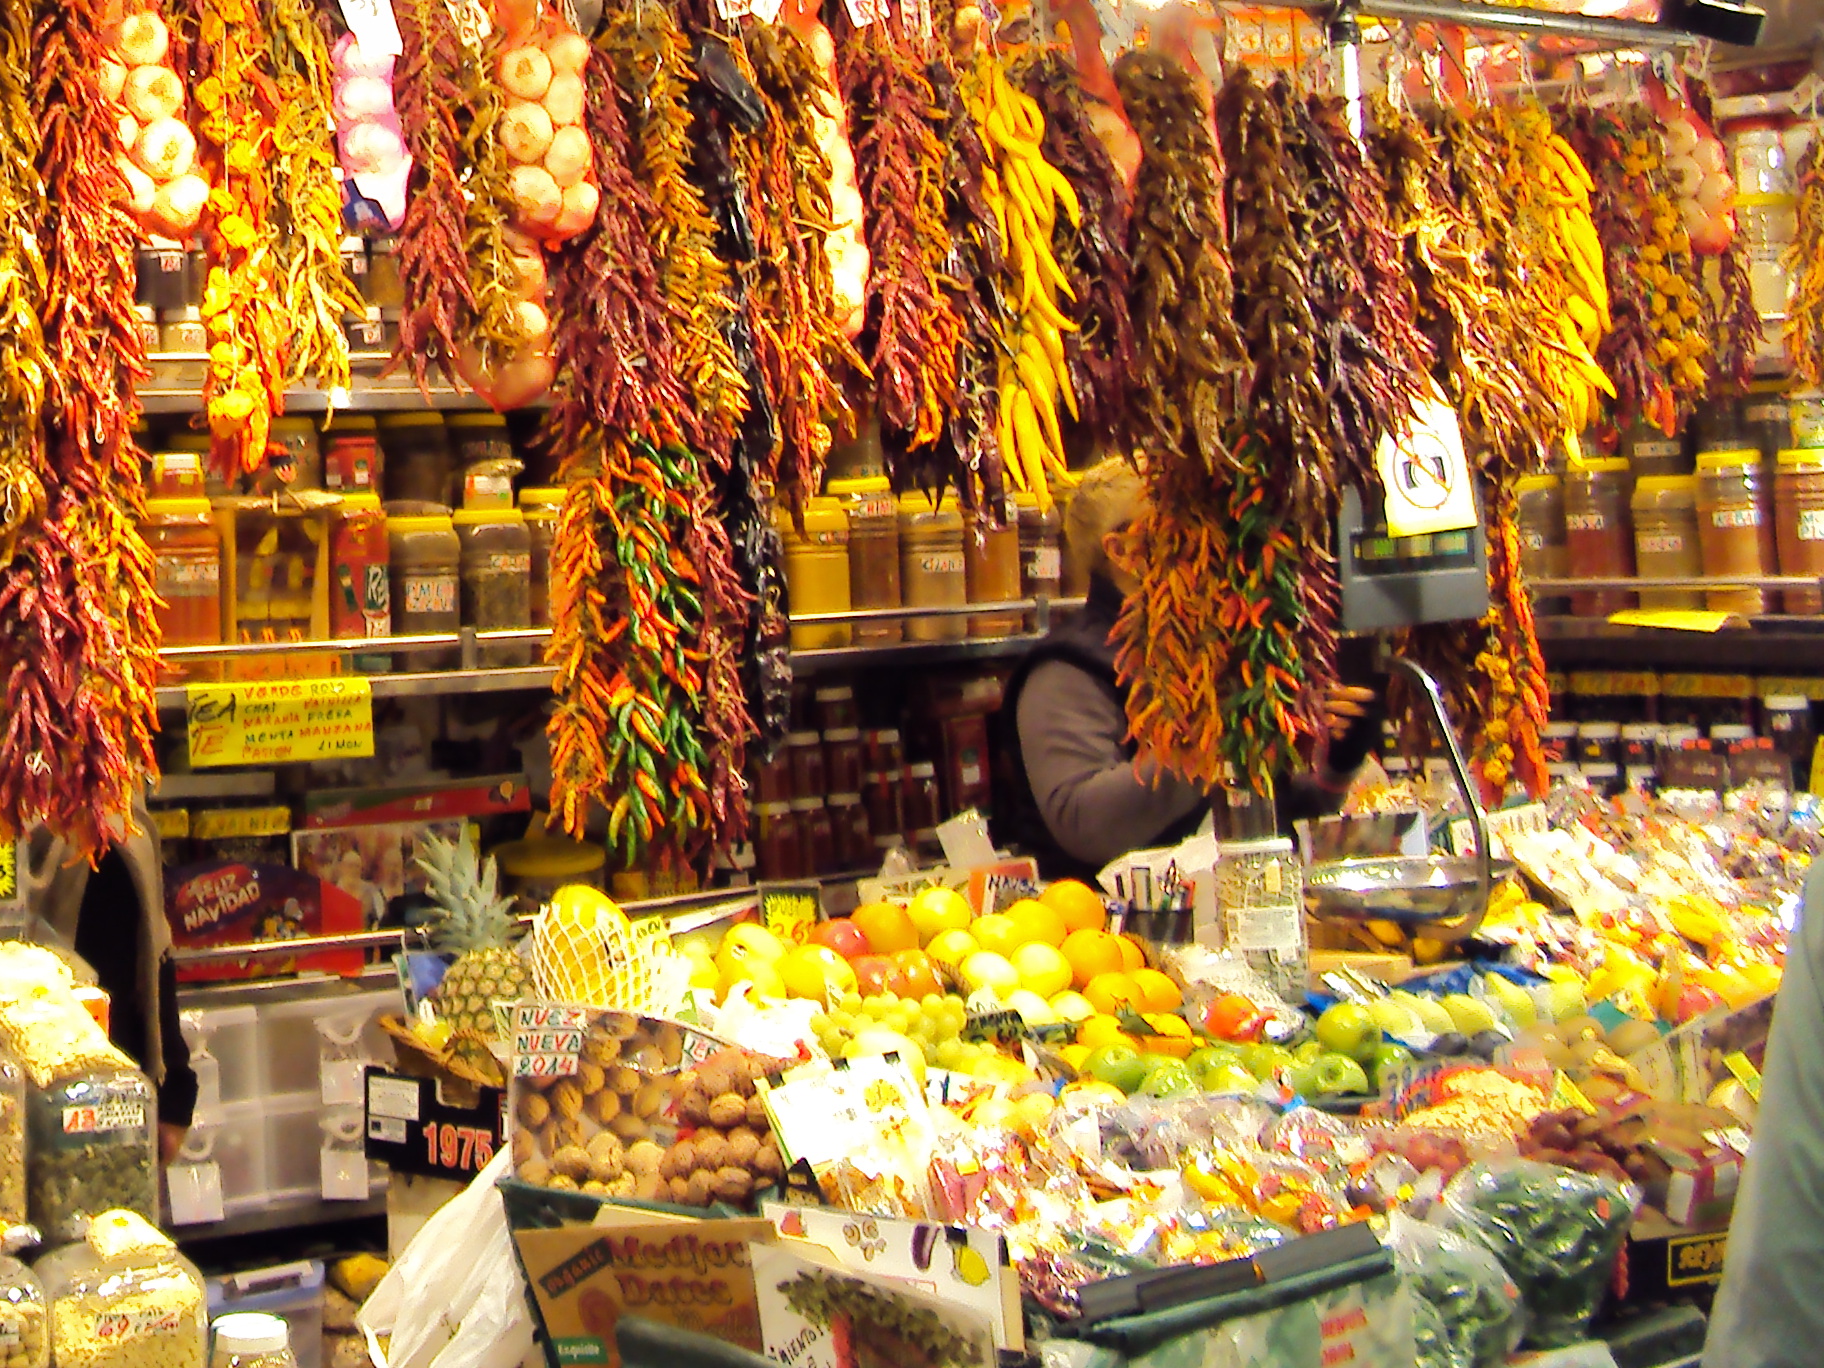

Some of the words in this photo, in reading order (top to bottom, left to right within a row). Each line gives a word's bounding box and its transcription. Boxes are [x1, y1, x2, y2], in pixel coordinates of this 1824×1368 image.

[182, 881, 261, 932] NAVIDAD
[517, 1032, 581, 1053] NUEVA
[422, 1120, 495, 1172] 1975
